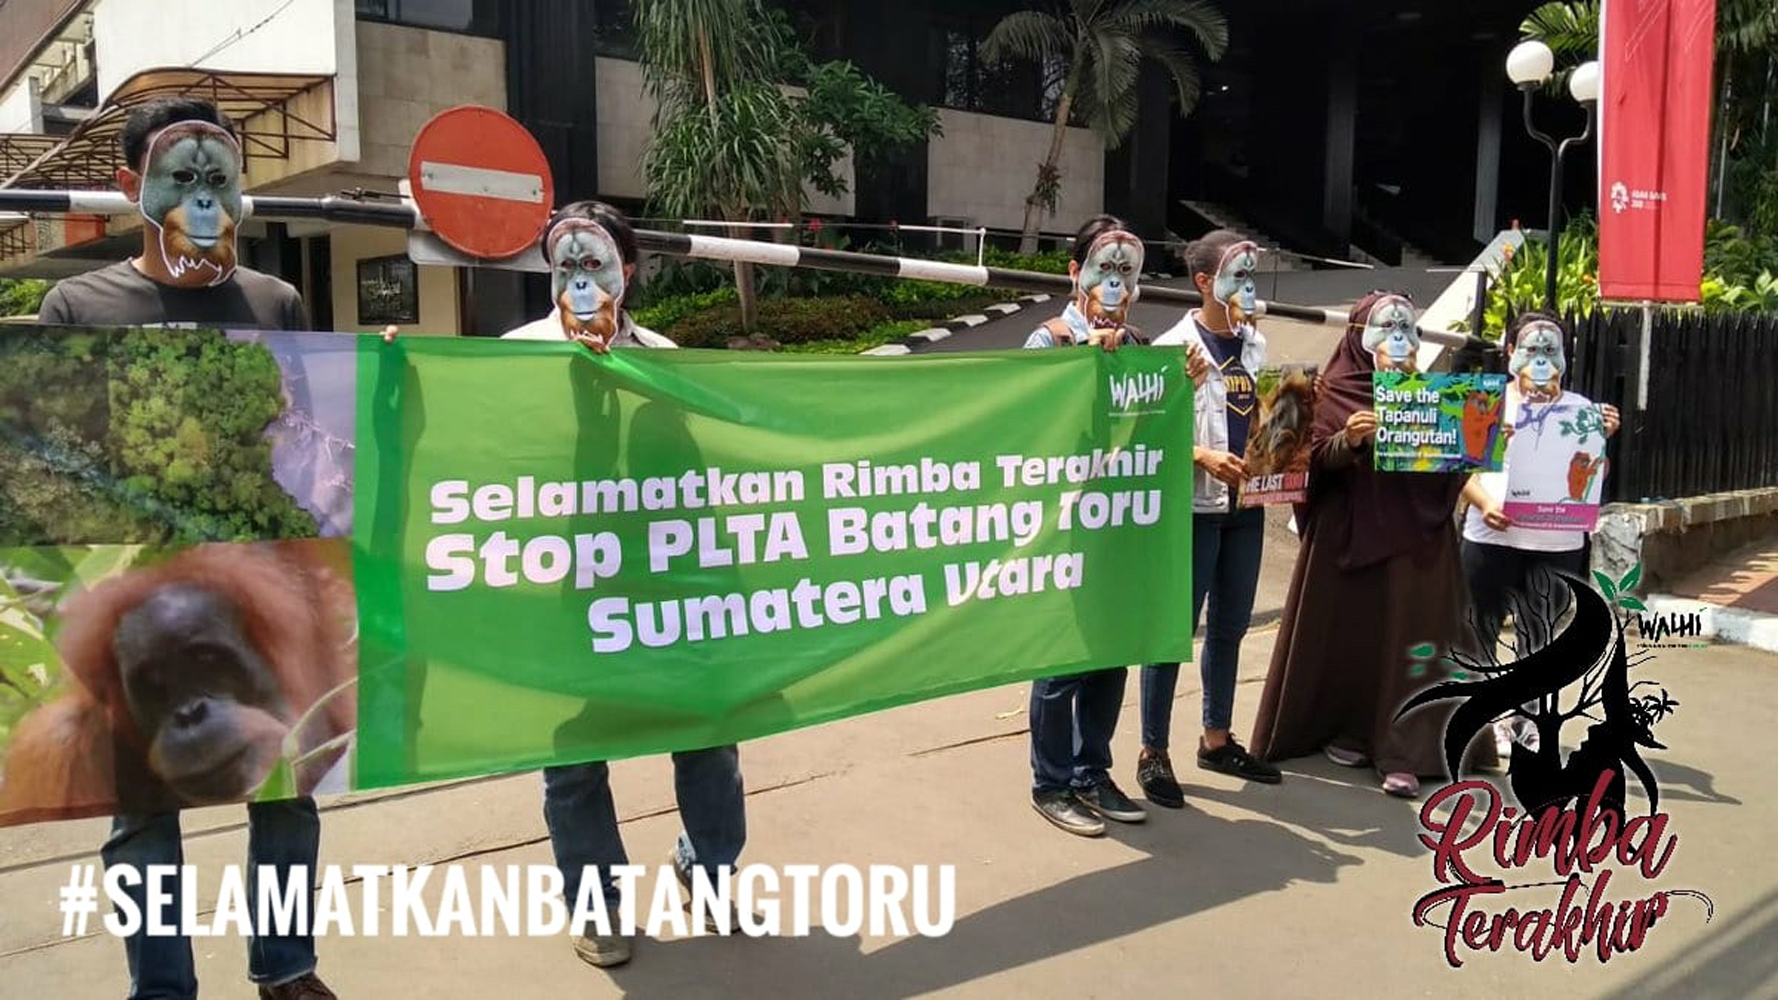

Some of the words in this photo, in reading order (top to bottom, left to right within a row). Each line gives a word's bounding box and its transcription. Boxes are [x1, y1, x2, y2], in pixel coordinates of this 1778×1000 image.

[1376, 386, 1412, 403] Save
[1416, 387, 1440, 403] the
[1378, 406, 1437, 426] Tapanuli
[1376, 427, 1457, 446] Orangutan!
[430, 467, 805, 525] Selamatkan
[822, 456, 982, 500] Rimba
[995, 445, 1165, 488] Terakhir
[1262, 473, 1284, 491] LAST
[426, 529, 623, 590] Stop
[648, 512, 808, 573] PLTA
[828, 500, 1044, 557] Batang
[1057, 489, 1163, 532] Toru
[588, 573, 928, 653] Sumatera
[943, 551, 1085, 607] Utara
